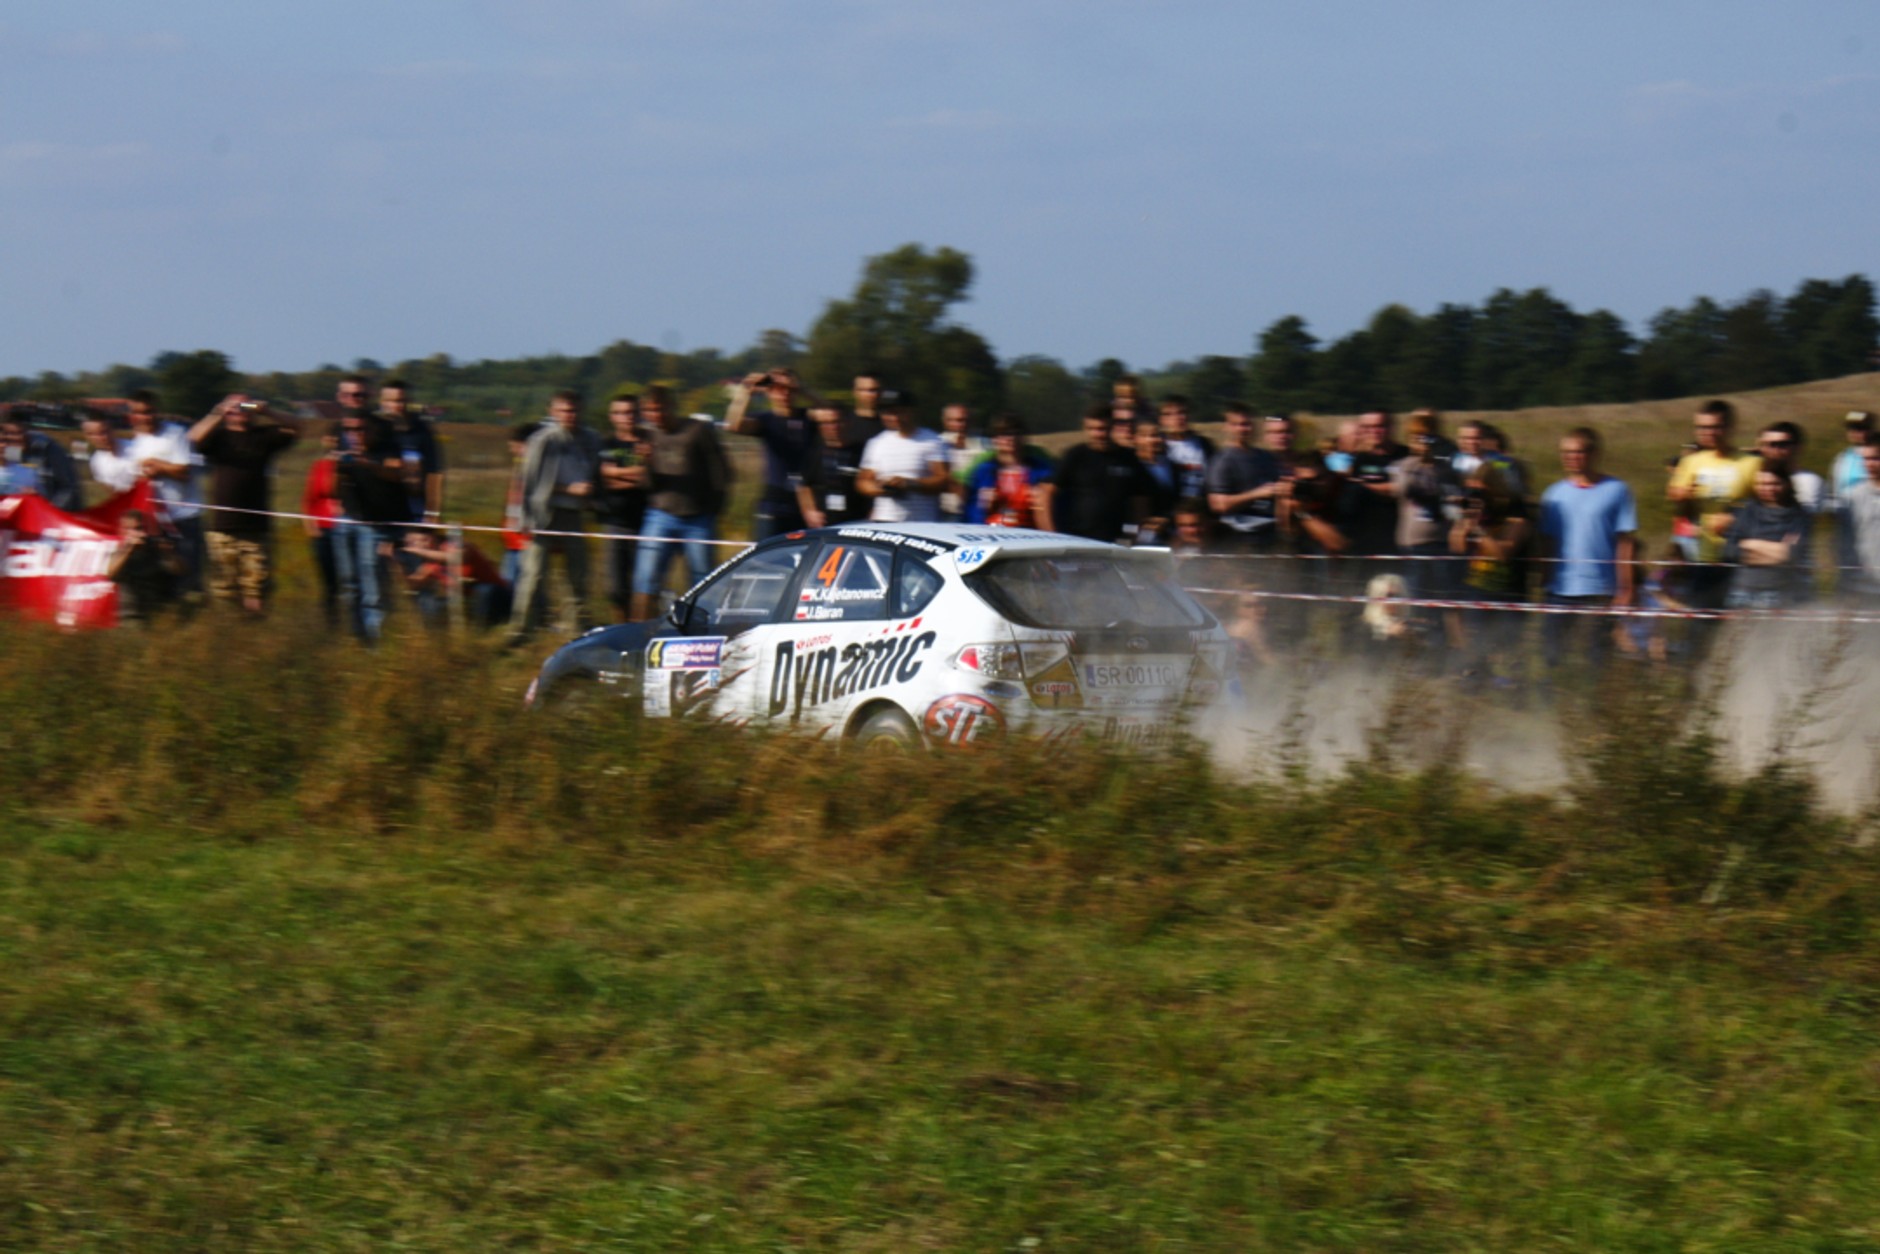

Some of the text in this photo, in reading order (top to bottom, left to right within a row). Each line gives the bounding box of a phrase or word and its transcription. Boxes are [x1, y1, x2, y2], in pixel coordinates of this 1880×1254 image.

[817, 546, 844, 587] 4
[649, 641, 664, 669] 4
[769, 630, 937, 723] Dynamic
[1097, 666, 1121, 685] SR
